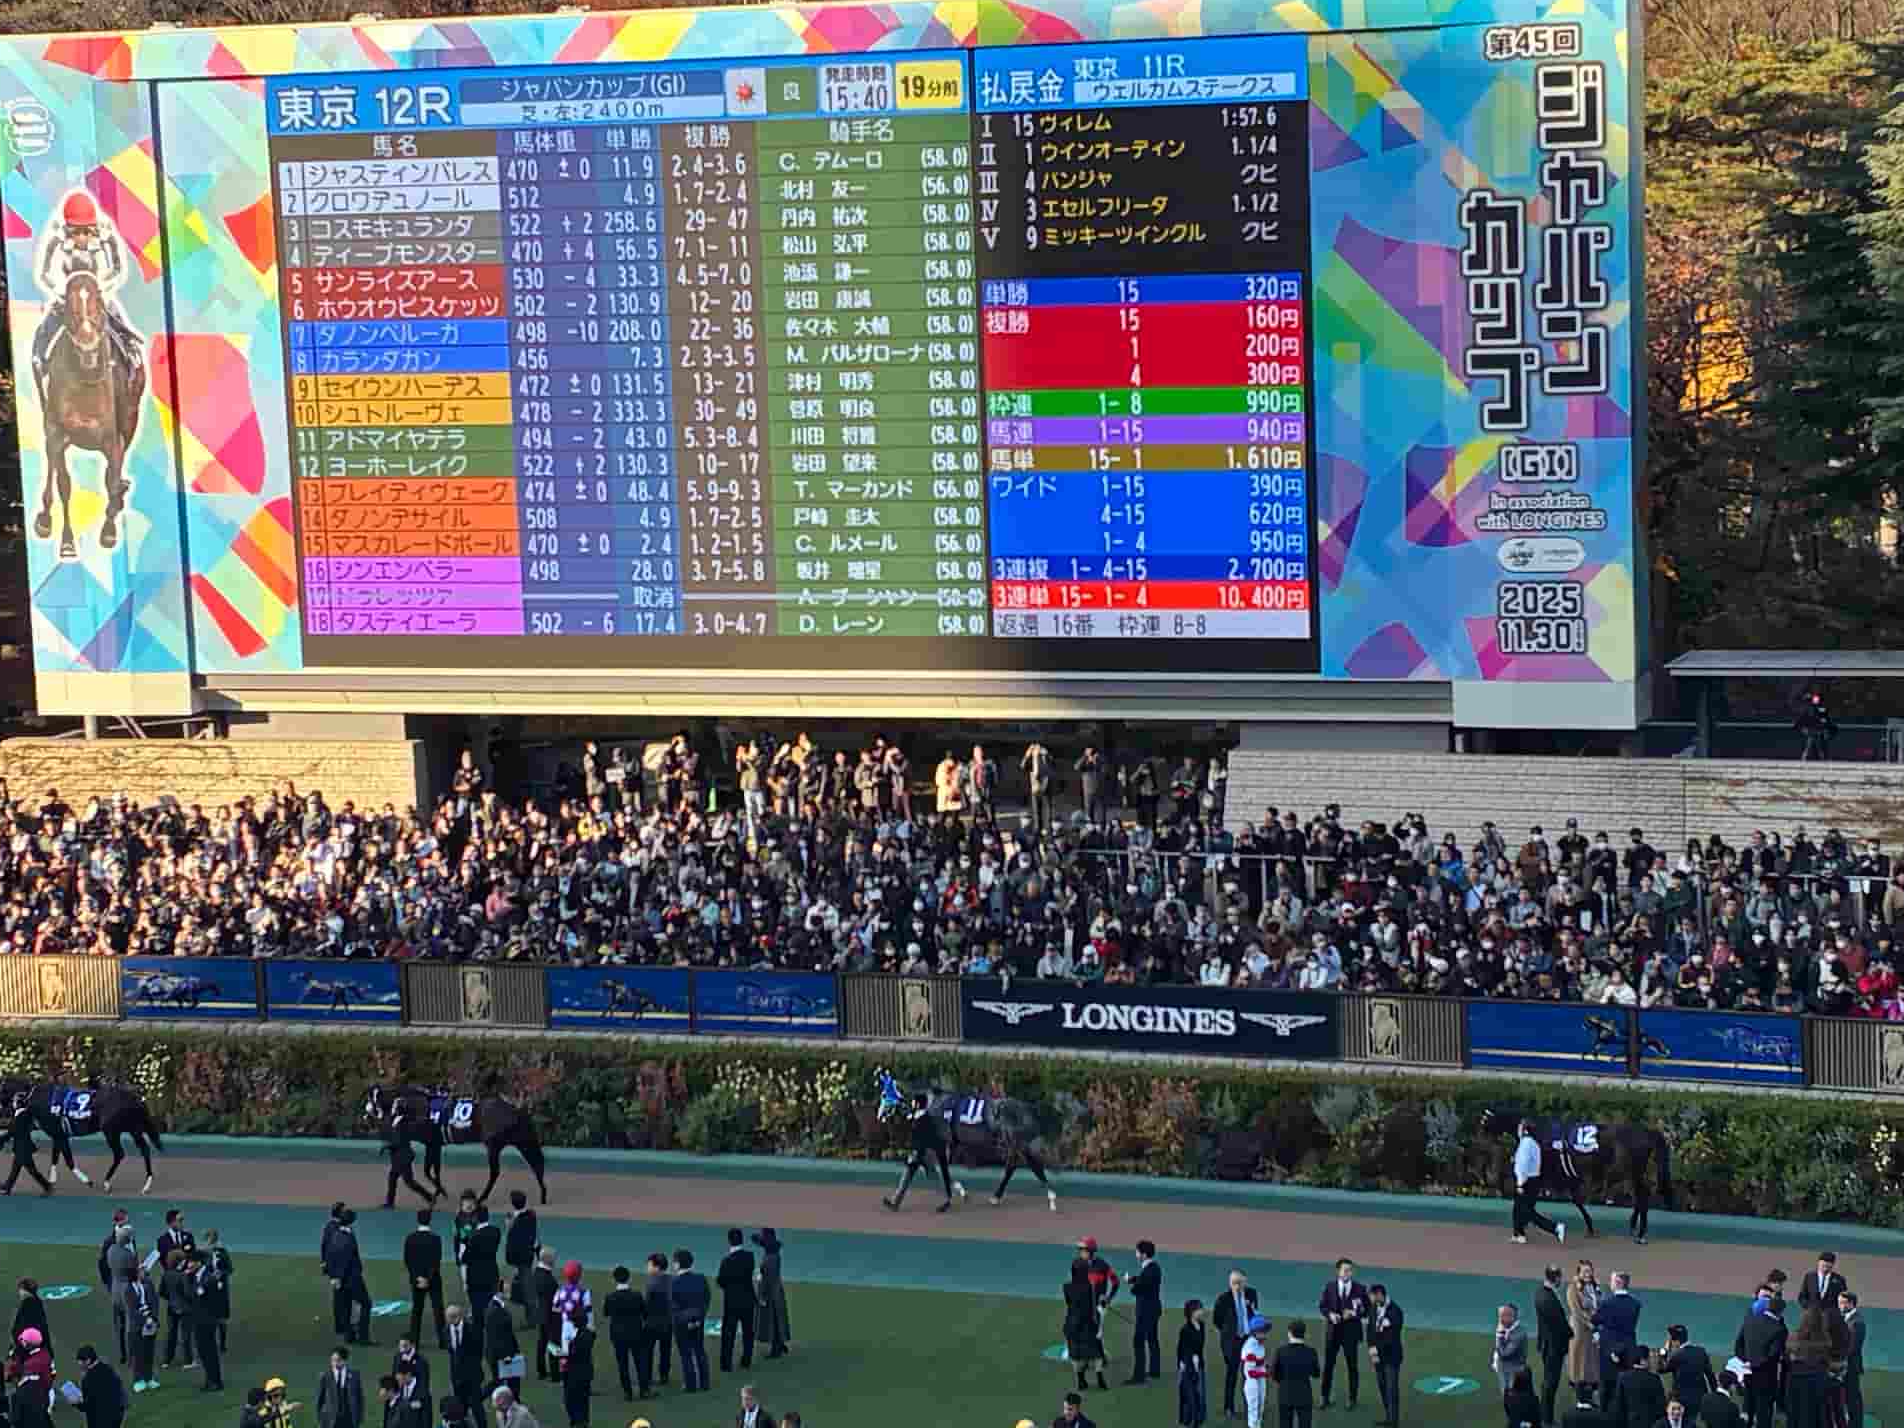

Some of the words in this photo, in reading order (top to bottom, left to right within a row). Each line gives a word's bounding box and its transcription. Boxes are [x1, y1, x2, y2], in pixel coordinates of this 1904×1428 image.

[1487, 25, 1578, 58] 第45回
[1074, 58, 1119, 80] 東京
[1143, 55, 1185, 78] 11R
[825, 86, 888, 112] 15:40
[981, 73, 1064, 107] 払戻金
[1093, 76, 1276, 102] ウェルカムステークス
[278, 89, 357, 127] 東京
[375, 87, 452, 125] 12R
[1015, 114, 1034, 137] 15
[1221, 107, 1278, 128] 1:57.6
[373, 135, 418, 156] 馬名
[513, 130, 577, 153] 馬体重
[606, 127, 653, 151] 単勝
[1025, 142, 1034, 164] 1
[286, 164, 296, 186] 1
[613, 157, 654, 178] 11.9
[1024, 171, 1035, 192] 4
[287, 191, 297, 213] 2
[623, 185, 656, 205] 4.9
[1026, 198, 1037, 220] 3
[289, 218, 299, 239] 3
[604, 212, 657, 234] 258.6
[1537, 63, 1610, 394] ジャパン
[1026, 227, 1037, 250] 9
[289, 245, 301, 266] 4
[615, 239, 658, 260] 56.5
[291, 271, 302, 293] 5
[315, 269, 479, 291] サンライズアース
[617, 266, 659, 287] 33.3
[1119, 281, 1138, 302] 15
[1245, 277, 1297, 301] 320円
[293, 296, 304, 319] 6
[608, 294, 661, 315] 130.9
[1119, 309, 1140, 331] 15
[1247, 305, 1299, 329] 160円
[1462, 190, 1540, 430] カップ
[609, 321, 662, 341] 208.0
[631, 348, 664, 367] 7.3
[1131, 337, 1138, 359] 1
[1246, 333, 1299, 357] 200円
[1129, 364, 1141, 386] 4
[1247, 361, 1300, 385] 300円
[298, 376, 308, 399] 9
[612, 375, 665, 395] 131.5
[297, 404, 314, 424] 10
[613, 402, 666, 422] 333.3
[1247, 390, 1301, 413] 990円
[297, 429, 316, 451] 11
[624, 428, 667, 449] 43.0
[1100, 420, 1144, 443] 1-15
[1247, 418, 1301, 442] 940円
[298, 456, 318, 477] 12
[330, 454, 467, 477] ヨーホーレイク
[616, 455, 668, 475] 130.3
[303, 484, 320, 503] 13
[627, 481, 670, 502] 48.4
[993, 475, 1056, 498] ワイド
[1101, 475, 1145, 497] 1-15
[1249, 475, 1304, 498] 390円
[304, 510, 322, 529] 14
[640, 507, 671, 527] 4.9
[1101, 503, 1145, 524] 4-15
[1249, 503, 1304, 525] 620円
[1510, 510, 1606, 530] LONGINES
[305, 536, 322, 555] 15
[640, 534, 672, 554] 2.4
[1249, 531, 1304, 553] 950円
[306, 560, 324, 581] 16
[631, 560, 673, 580] 28.0
[1499, 582, 1582, 618] 2025
[309, 613, 328, 633] 18
[634, 613, 675, 633] 17.4
[1173, 613, 1206, 635] 8-8
[1061, 1002, 1236, 1038] LONGINES
[76, 1093, 91, 1111] 9
[453, 1100, 473, 1120] 10
[1578, 1125, 1598, 1146] 12
